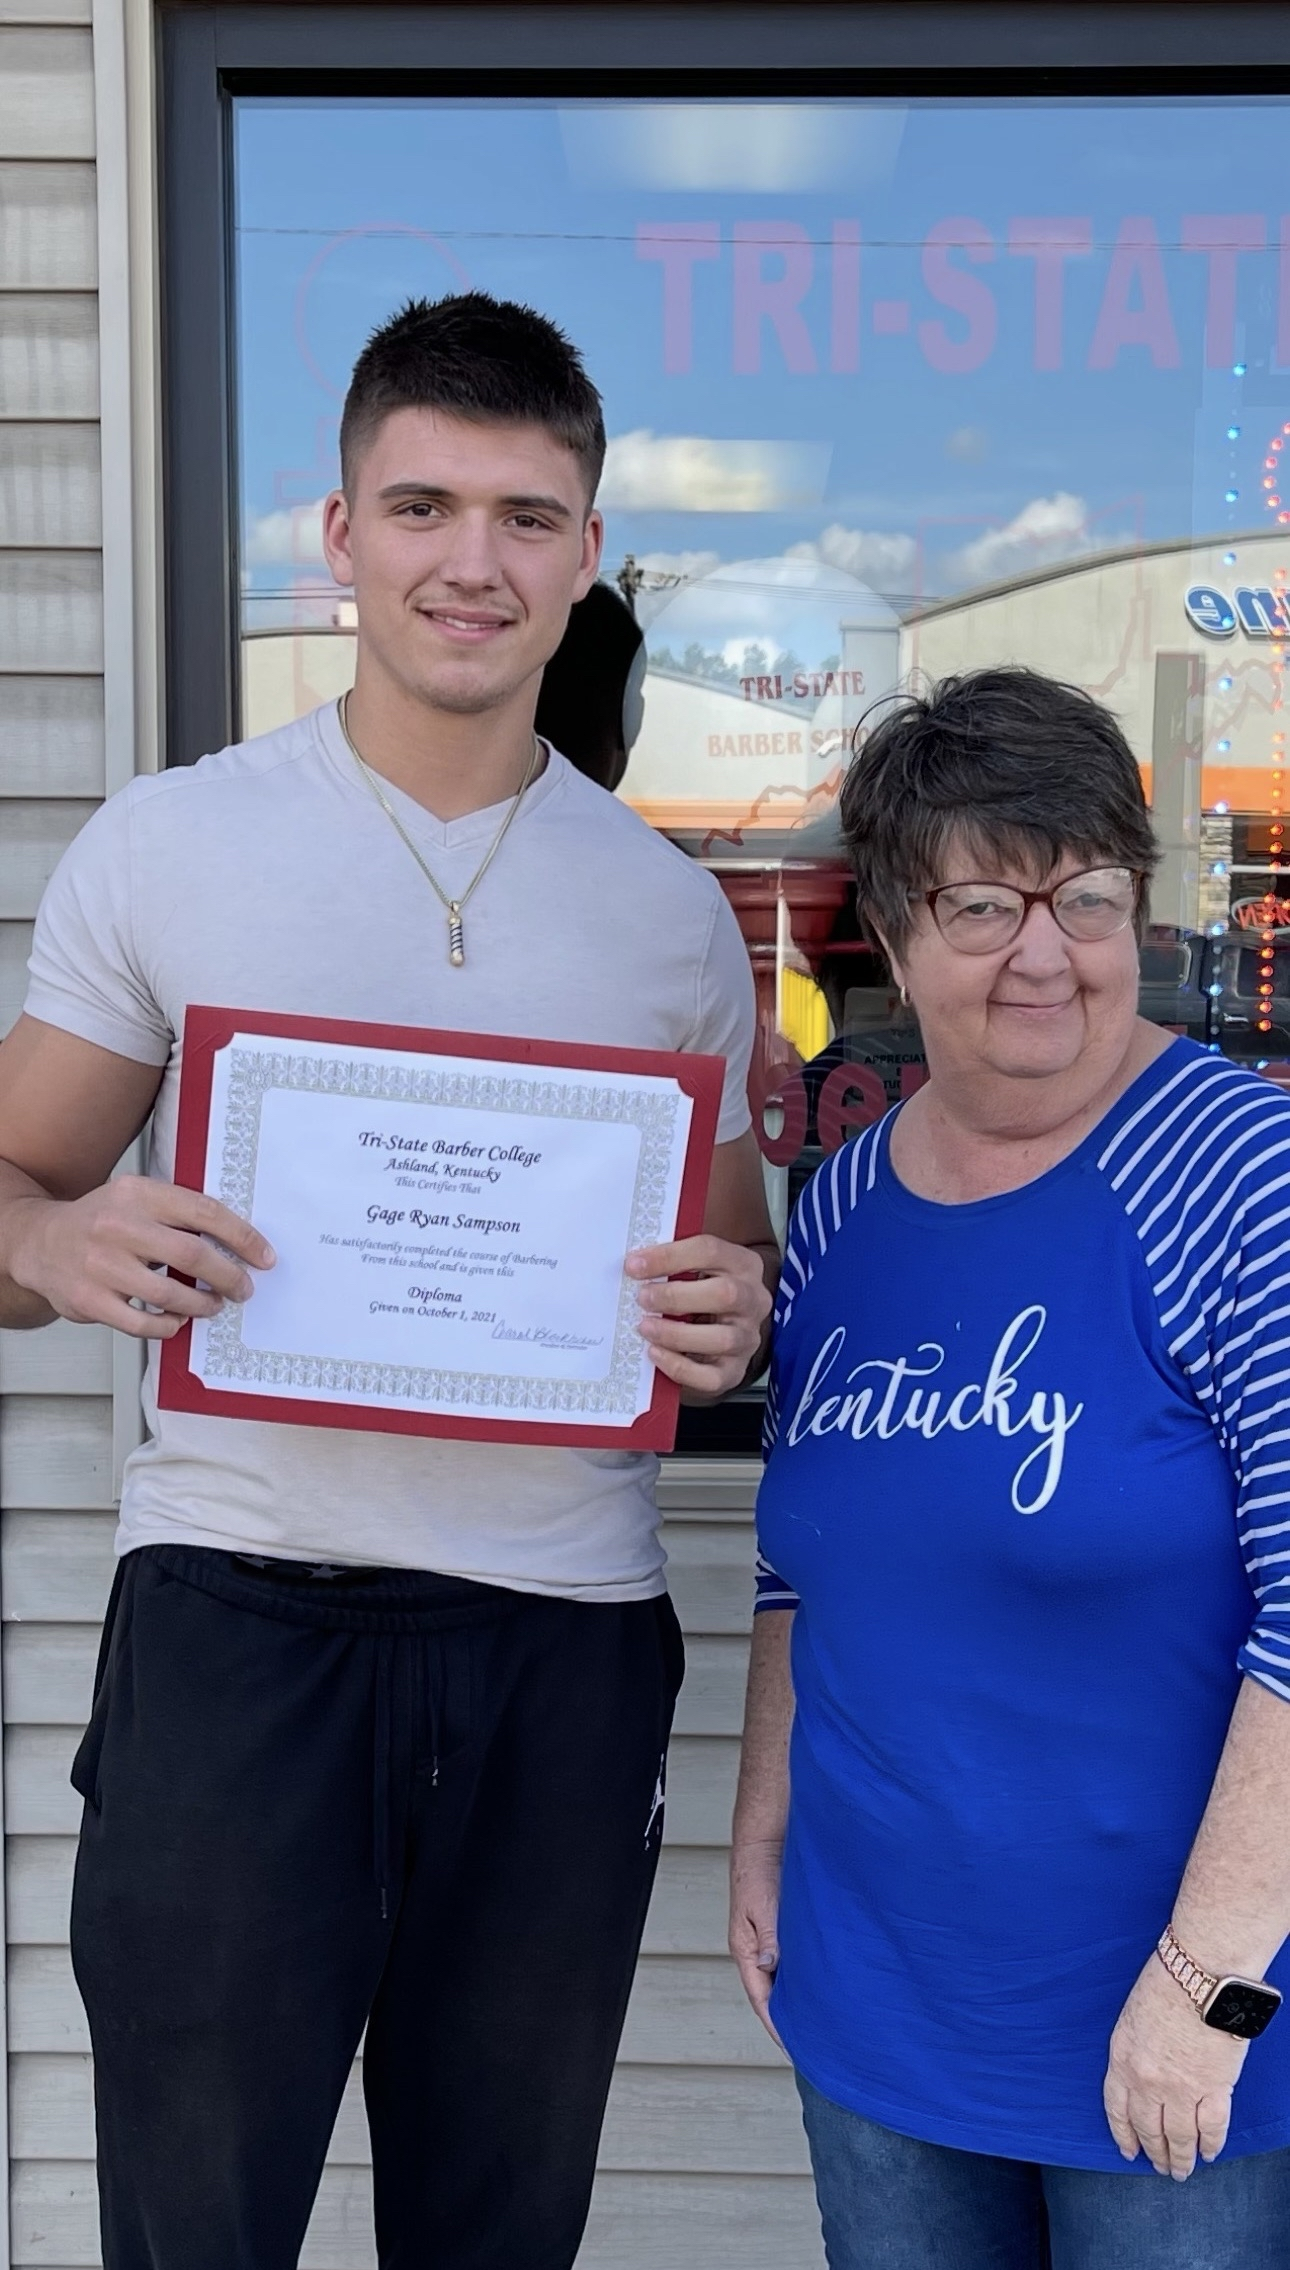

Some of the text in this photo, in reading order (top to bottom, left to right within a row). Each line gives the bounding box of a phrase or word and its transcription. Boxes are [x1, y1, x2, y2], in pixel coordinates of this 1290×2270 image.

[636, 214, 1290, 375] TRI-STAT
[740, 671, 866, 701] TRI-STATE
[708, 726, 872, 757] BARBER SCHO
[864, 1054, 926, 1064] APPRECIAT
[358, 1132, 542, 1167] Tri-State Barber College
[383, 1158, 501, 1183] Ashland, Kentucky
[395, 1177, 481, 1194] This Certifies That
[367, 1205, 521, 1235] Gage Ryan Sampson
[319, 1233, 558, 1269] Has satisfactorily completed the course of Barbering
[361, 1254, 515, 1277] From this school and is given this
[407, 1286, 462, 1303] Diploma
[369, 1301, 496, 1324] Given on October 1, 2021
[786, 1304, 1084, 1515] kentucky
